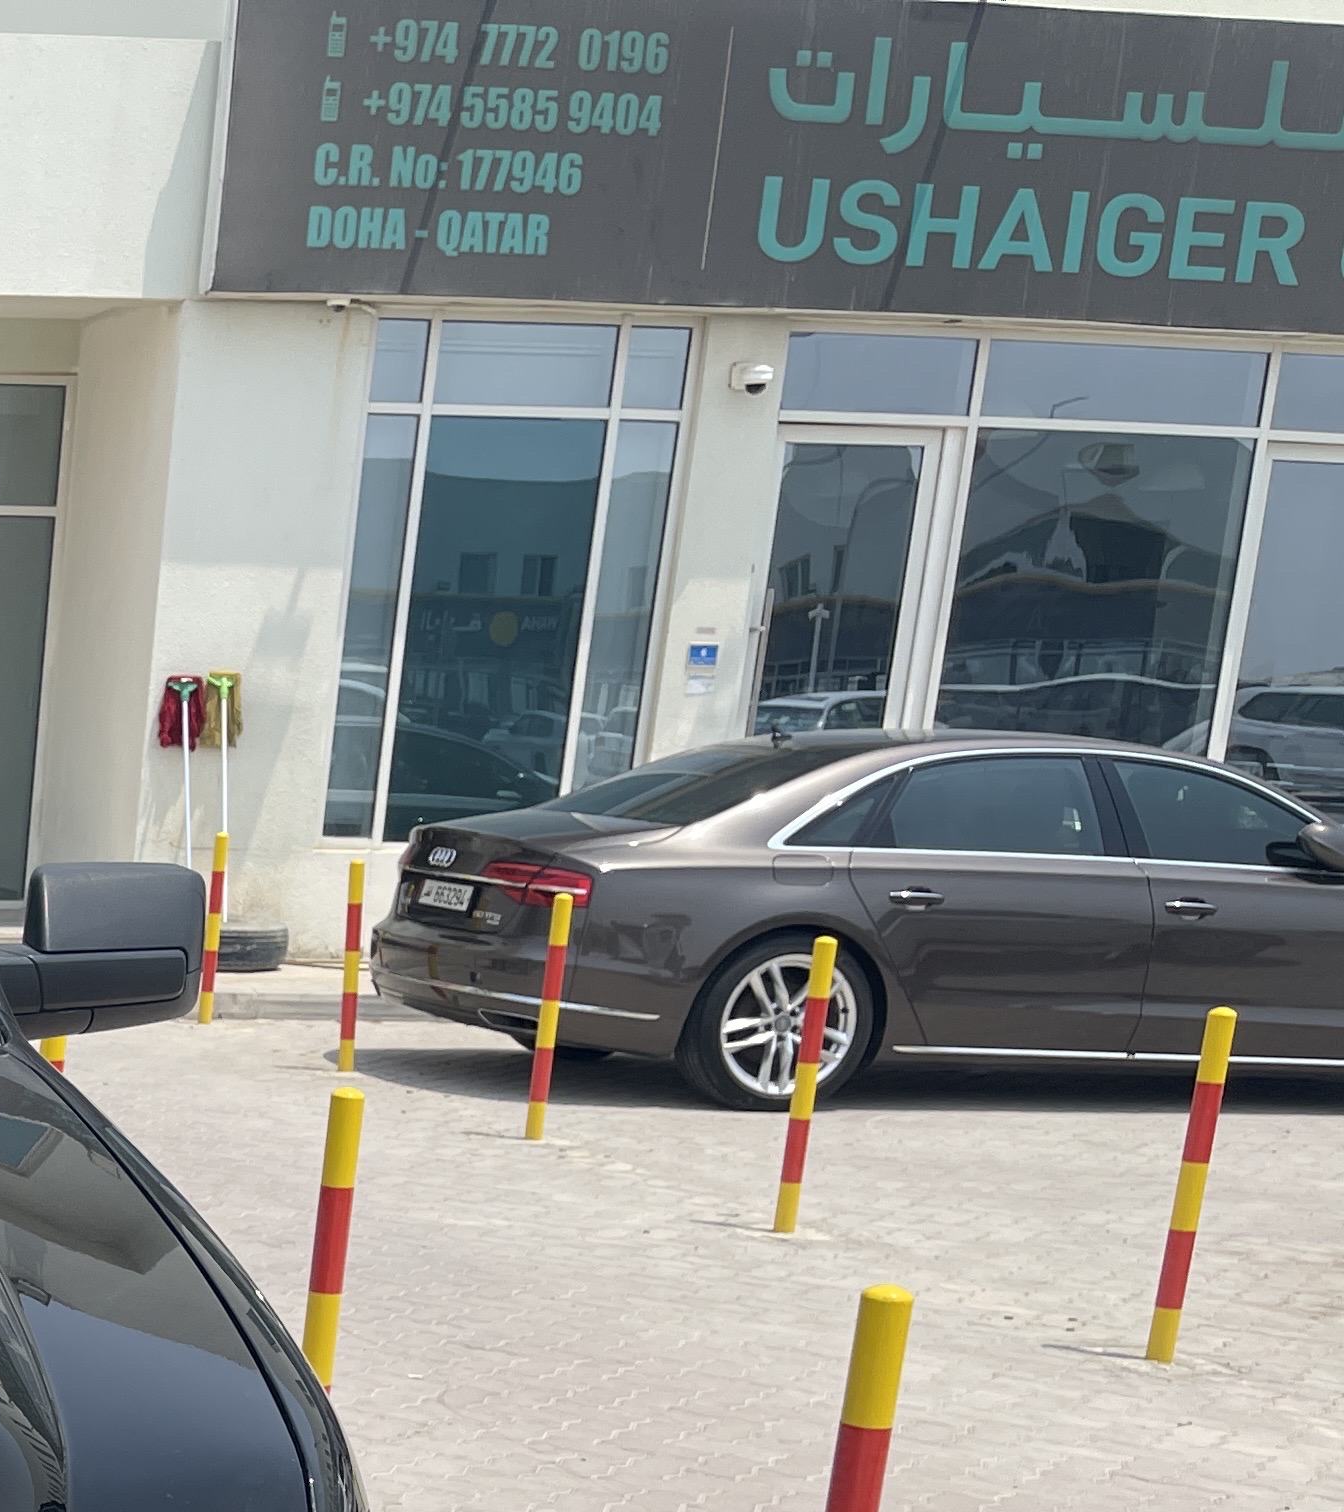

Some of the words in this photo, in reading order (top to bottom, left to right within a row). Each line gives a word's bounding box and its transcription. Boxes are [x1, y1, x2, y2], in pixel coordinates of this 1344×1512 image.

[369, 18, 459, 64] +974
[480, 23, 559, 69] 7772
[578, 28, 670, 75] 0196
[363, 81, 453, 127] +974
[460, 86, 559, 132] 5585
[567, 90, 662, 136] 9404
[768, 36, 1344, 160] لسيارات
[314, 143, 380, 188] C.R.
[389, 146, 449, 190] No:
[456, 149, 583, 196] 177946
[307, 206, 406, 250] DOHA
[436, 209, 550, 257] QATAR
[757, 175, 1306, 286] USHAIGER
